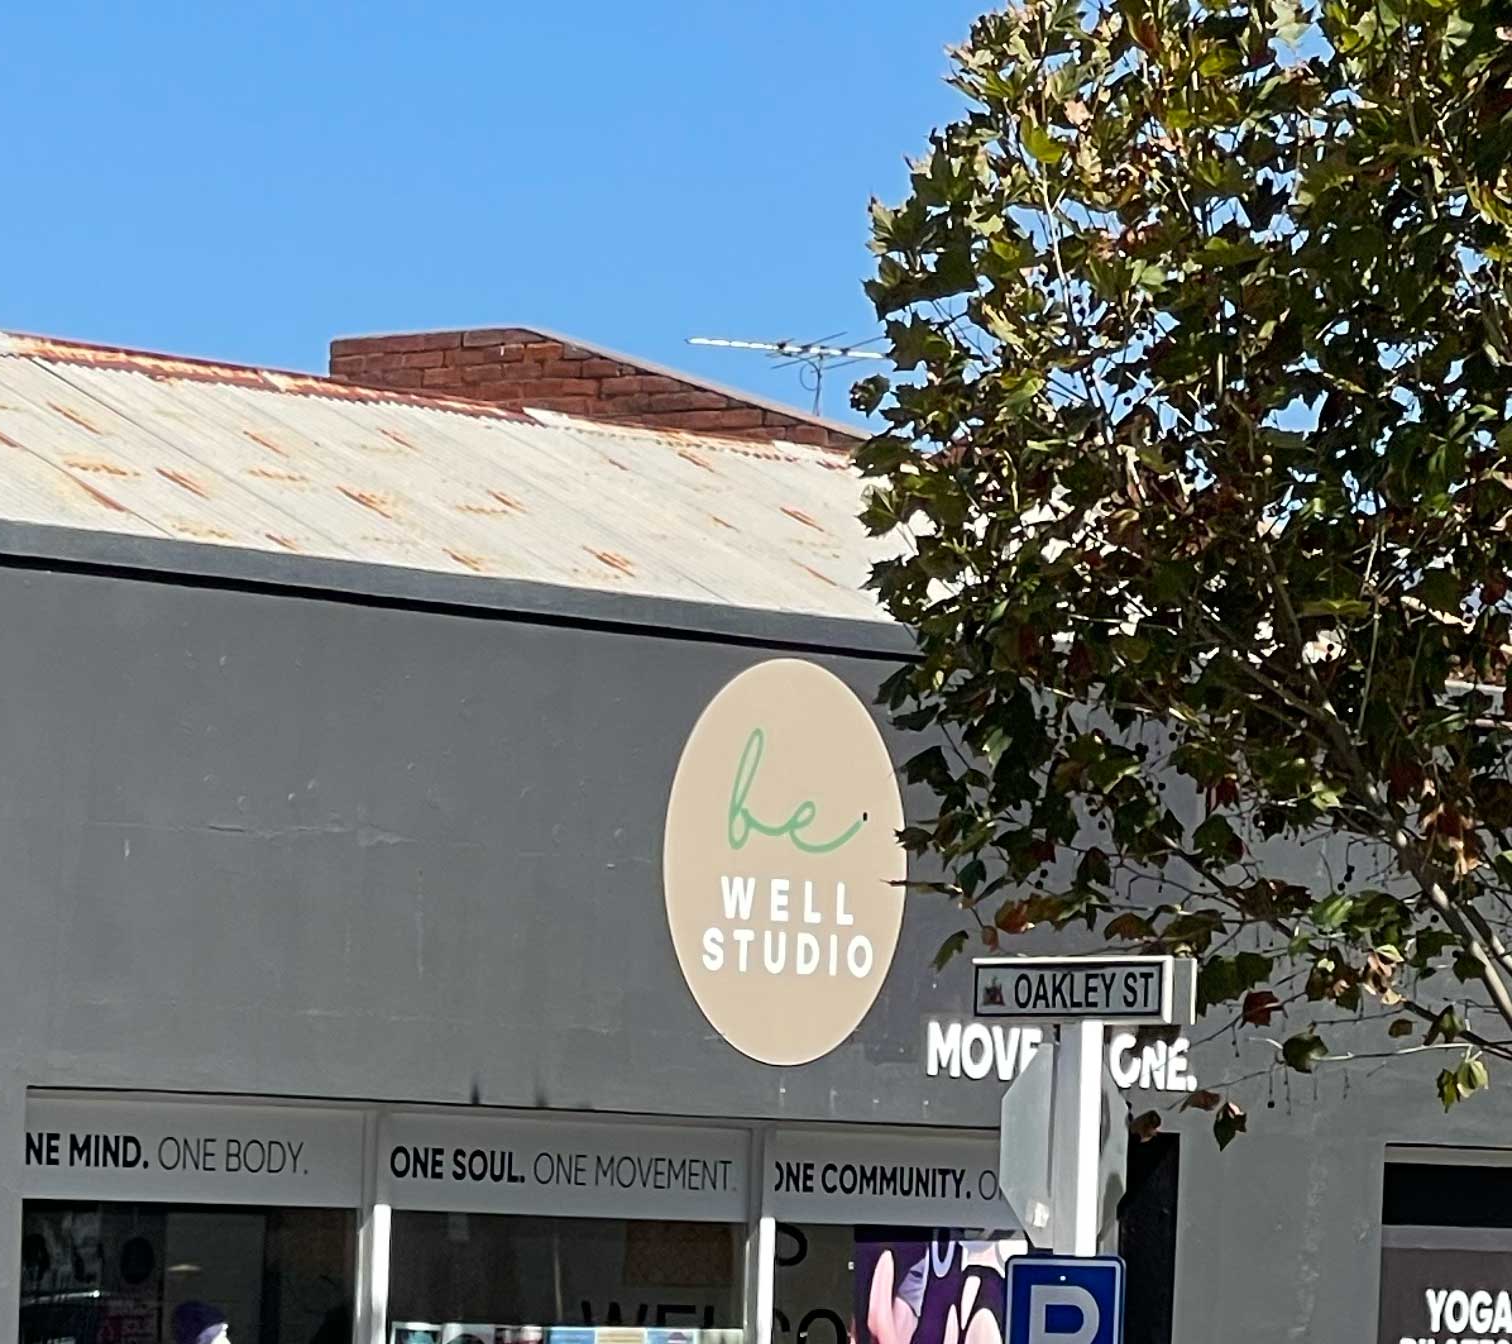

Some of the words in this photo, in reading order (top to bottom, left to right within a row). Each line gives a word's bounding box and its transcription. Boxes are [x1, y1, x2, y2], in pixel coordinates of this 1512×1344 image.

[720, 875, 854, 926] WELL
[702, 926, 874, 979] STUDIO
[1013, 972, 1116, 1009] OAKLEY
[1122, 971, 1155, 1009] ST
[24, 1131, 61, 1166] NE
[68, 1133, 149, 1170] MIND.
[158, 1136, 216, 1173] ONE
[225, 1138, 308, 1175] BODY.
[390, 1145, 445, 1180] ONE
[451, 1148, 526, 1184] SOUL.
[533, 1152, 587, 1187] ONE
[594, 1155, 737, 1193] MOVEMENT.
[821, 1163, 972, 1200] COMMUNITY.
[1425, 1287, 1512, 1334] YOGA
